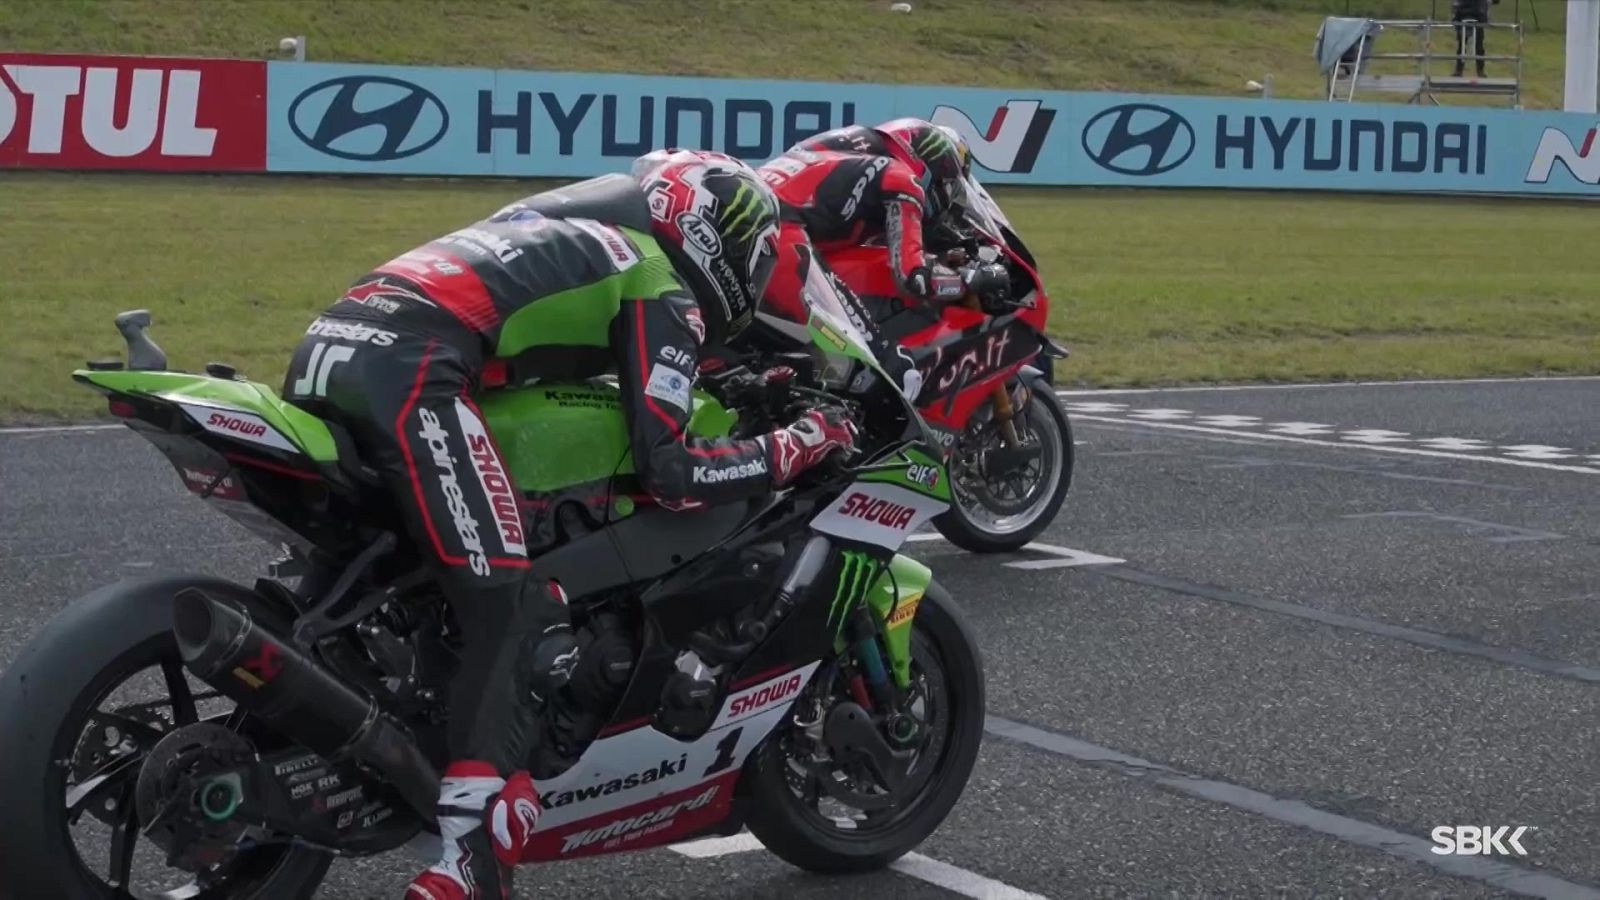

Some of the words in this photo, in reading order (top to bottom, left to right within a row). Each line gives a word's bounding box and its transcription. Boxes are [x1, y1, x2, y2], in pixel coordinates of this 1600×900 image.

[1215, 114, 1488, 175] HYUNDAI
[685, 220, 718, 253] Arai
[717, 259, 747, 311] MONSTER
[660, 345, 691, 366] elf
[207, 412, 267, 437] SHOWA
[468, 433, 524, 546] SHOWA
[692, 458, 769, 484] Kawasaki
[906, 464, 930, 484] elf
[418, 407, 491, 577] alpinestars
[838, 492, 916, 530] SHOWA
[728, 674, 801, 718] SHOWA
[703, 726, 744, 779] 1
[318, 773, 341, 790] RK
[537, 753, 688, 811] Kawasaki
